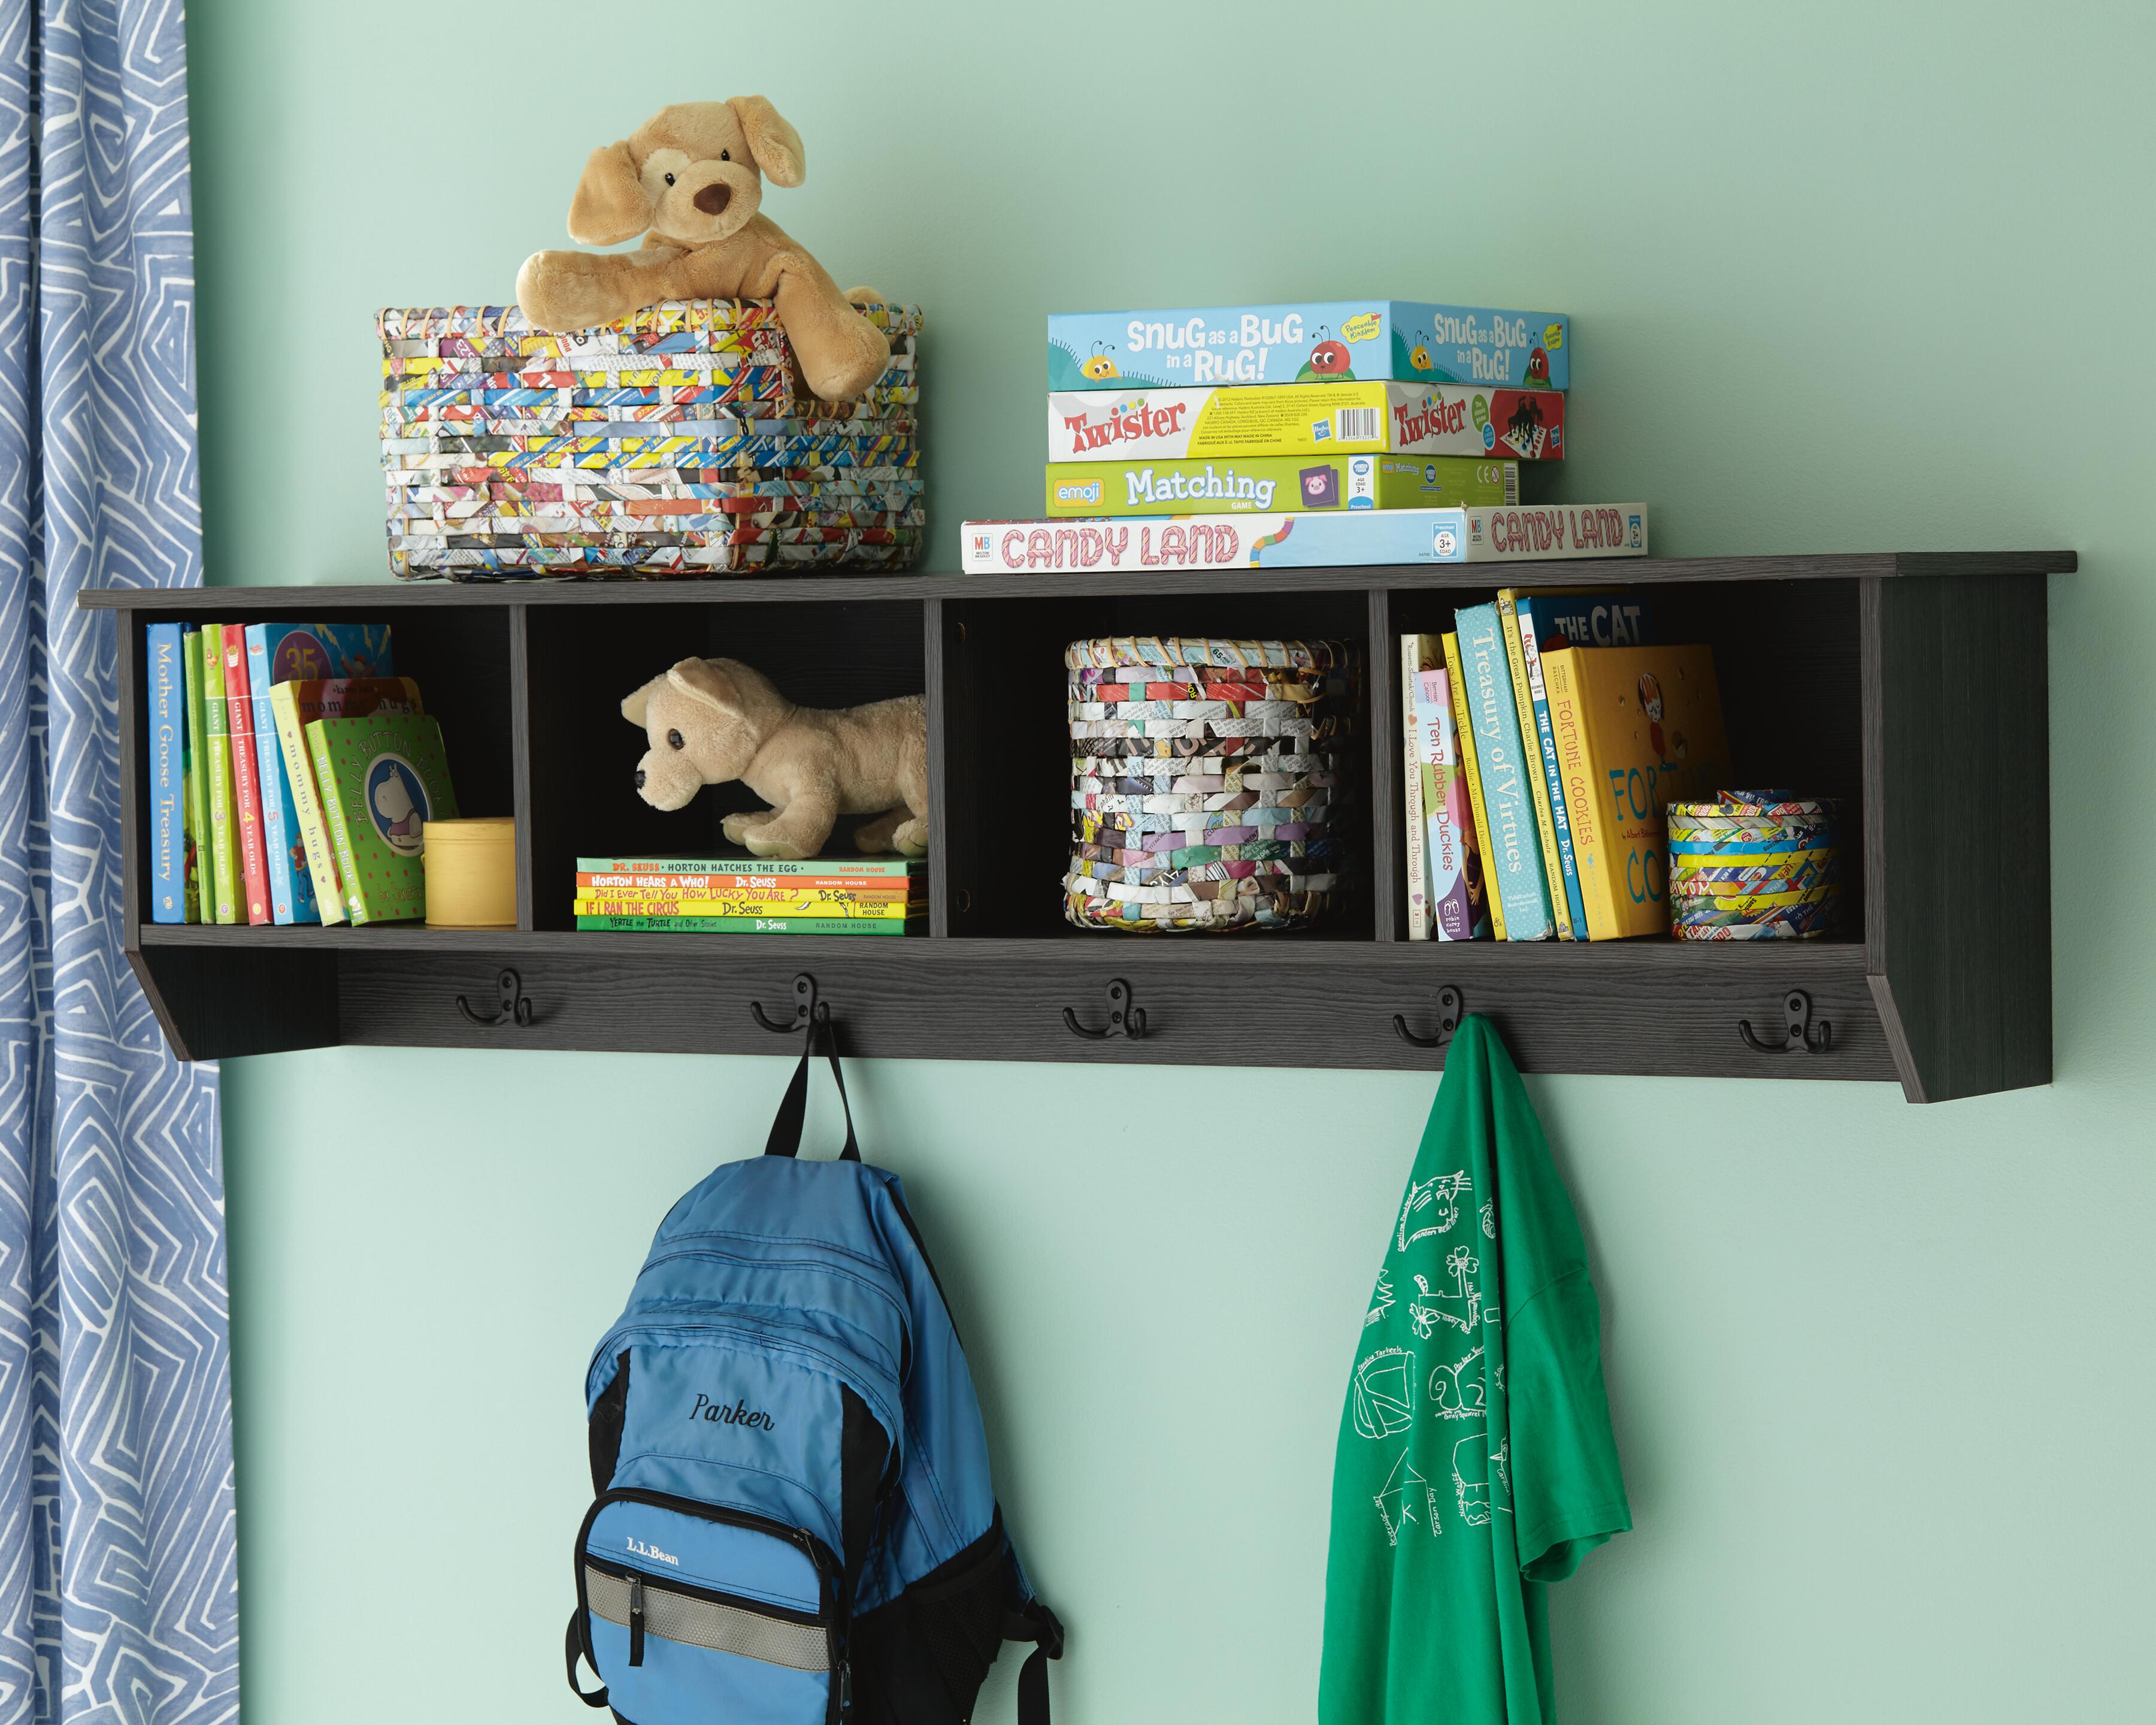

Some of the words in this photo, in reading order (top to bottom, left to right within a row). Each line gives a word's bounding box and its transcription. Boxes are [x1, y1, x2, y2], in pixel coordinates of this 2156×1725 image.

[1208, 331, 1225, 344] as
[1229, 330, 1238, 344] a
[1345, 319, 1377, 333] Peaceable
[1350, 326, 1376, 340] Kingdom
[1166, 353, 1180, 368] in
[1183, 353, 1191, 368] a
[1064, 402, 1186, 453] Twister
[1394, 397, 1466, 447] Twister
[1395, 462, 1419, 476] Matching
[1057, 482, 1100, 503] emoji
[1124, 464, 1277, 510] Matching
[975, 537, 990, 550] MB
[1440, 539, 1451, 548] 3+
[1491, 510, 1564, 552] CANDY
[1570, 509, 1623, 549] LAND
[1001, 526, 1128, 568] CANDY
[1141, 525, 1239, 566] LAND
[1555, 616, 1589, 640] THE
[1591, 605, 1640, 647] CAT
[156, 643, 172, 718] Mother
[1512, 658, 1521, 681] Great
[1473, 628, 1503, 742] Treasury
[1455, 697, 1460, 707] to
[1515, 683, 1528, 722] Pumpkin,
[1427, 717, 1444, 748] Ten
[1457, 708, 1467, 739] Tickle
[1539, 711, 1549, 733] THE
[359, 732, 411, 758] BUTTON
[1408, 734, 1417, 758] Love
[1524, 722, 1534, 751] Charlie
[1543, 737, 1555, 761] CAT
[158, 724, 174, 788] Goose
[213, 740, 222, 786] TREASURY
[1490, 746, 1515, 774] of
[1530, 753, 1538, 782] Brown
[238, 739, 249, 786] TREASURY
[244, 812, 255, 823] 4
[1430, 749, 1446, 806] Rubber
[1549, 765, 1556, 776] IN
[1558, 700, 1580, 770] FORTUNE
[1570, 777, 1594, 845] COOKIES
[350, 756, 369, 827] BELLY
[1410, 782, 1419, 821] Through
[1551, 782, 1560, 801] THE
[214, 811, 226, 821] 3
[289, 744, 311, 815] mommy
[308, 827, 323, 868] hugs
[316, 753, 333, 792] BELLY
[326, 797, 346, 846] BUTTON
[339, 849, 356, 886] BOOK!
[1471, 788, 1484, 828] MacDonald
[1555, 806, 1567, 830] HAT
[158, 794, 174, 881] Treasury
[1496, 779, 1522, 873] Virtues
[1436, 811, 1454, 871] Duckies
[1478, 830, 1486, 856] Denton
[1561, 839, 1569, 853] Dr.
[613, 863, 629, 871] DR.
[632, 863, 659, 871] SEUSS
[1412, 843, 1421, 883] Through
[1549, 863, 1557, 891] RANDOM
[1563, 854, 1572, 876] Seuss
[592, 875, 632, 886] HORTON
[636, 876, 666, 887] HEARS
[670, 877, 677, 887] A
[679, 875, 709, 888] WHO!
[735, 876, 749, 888] Dr.
[750, 876, 776, 888] Seuss
[595, 889, 608, 898] Did
[610, 889, 614, 898] I
[641, 889, 656, 899] Tell
[660, 889, 677, 900] You
[586, 901, 595, 915] IF
[597, 901, 601, 915] I
[604, 901, 623, 915] RAN
[625, 901, 644, 915] THE
[647, 901, 680, 916] CIRCUS
[722, 902, 737, 915] Dr.
[739, 901, 763, 915] Seuss
[818, 890, 832, 901] Dr.
[833, 890, 856, 902] Seuss
[610, 917, 633, 928] YERTLE
[647, 918, 670, 927] TURTLE
[756, 920, 767, 930] Dr.
[768, 920, 786, 930] Seuss
[689, 1394, 774, 1430] Parker
[1428, 1488, 1437, 1503] Day
[626, 1537, 679, 1566] L.L.Bean
